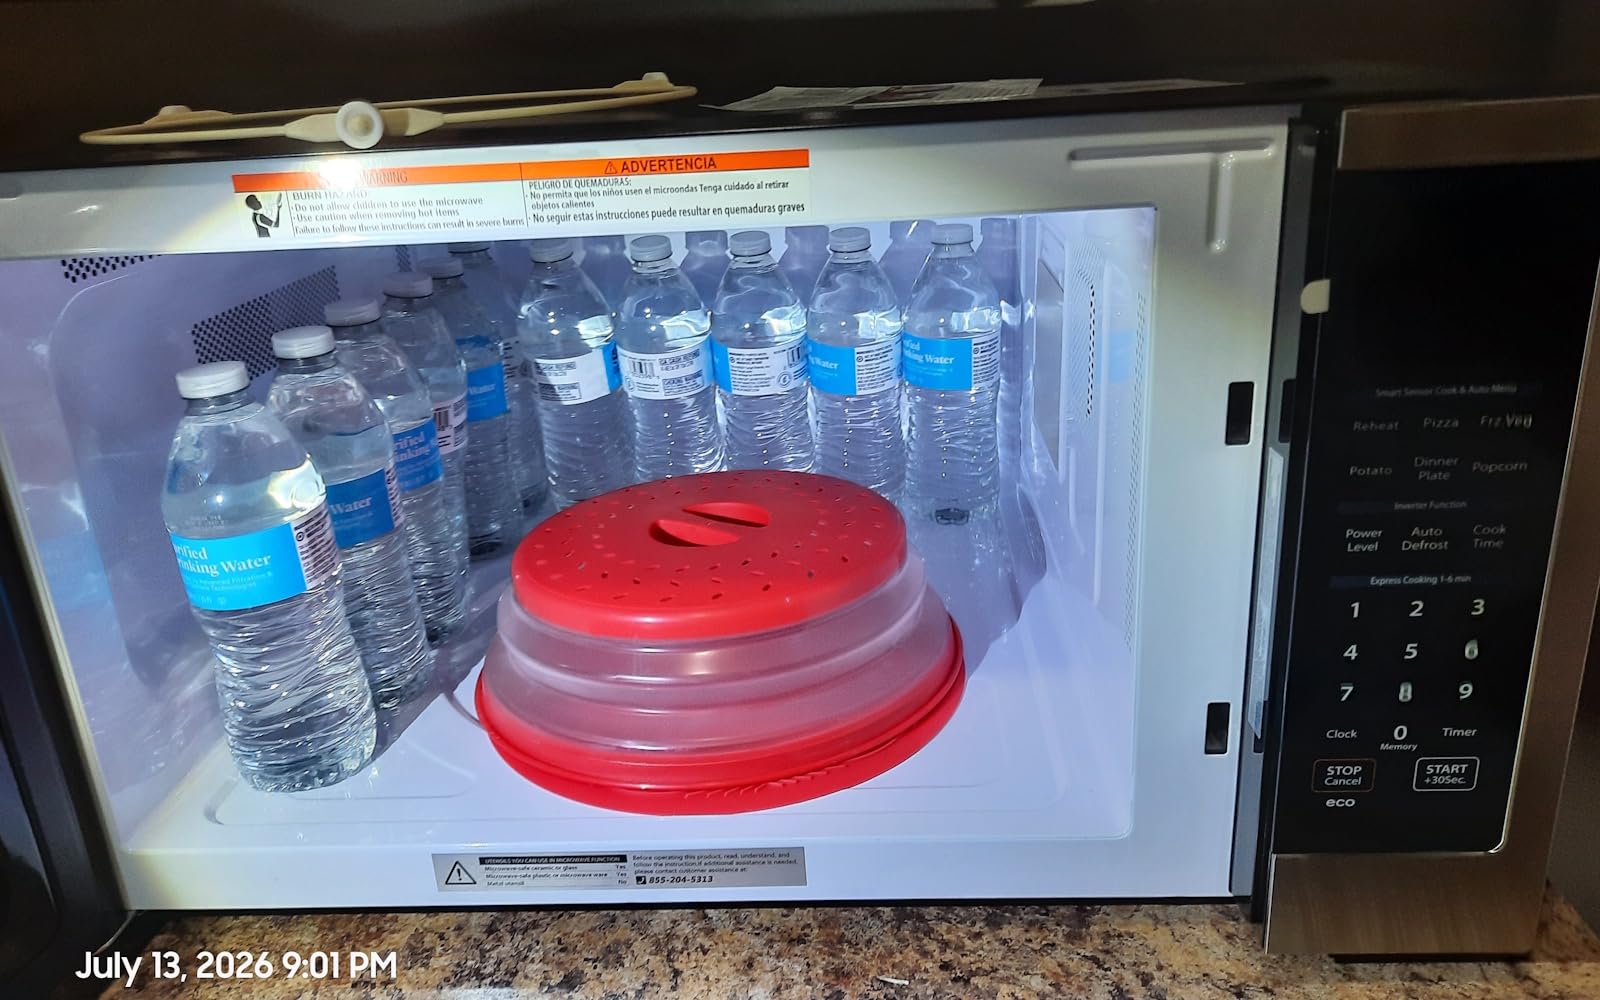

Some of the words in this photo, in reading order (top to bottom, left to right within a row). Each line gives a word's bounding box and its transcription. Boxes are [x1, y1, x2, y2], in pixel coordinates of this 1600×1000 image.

[621, 157, 717, 173] ADVERTENCIA
[361, 171, 408, 185] WARNING
[529, 180, 561, 190] PELIGRO
[562, 180, 573, 188] DE
[574, 178, 632, 187] QUEMADURAS:
[293, 191, 321, 200] BURN
[542, 190, 572, 199] permita
[574, 190, 588, 199] que
[590, 188, 600, 197] los
[602, 187, 624, 196] niños
[626, 187, 643, 195] usen
[645, 186, 652, 194] el
[654, 184, 698, 194] microondas
[700, 184, 722, 193] Tenga
[724, 181, 754, 191] cuidado
[756, 181, 763, 189] al
[765, 181, 789, 189] retirar
[294, 203, 305, 211] Do
[308, 202, 323, 211] not
[327, 202, 350, 210] allow
[353, 200, 387, 209] children
[390, 199, 399, 207] to
[402, 199, 416, 207] use
[419, 198, 433, 206] the
[436, 196, 483, 205] microwave
[531, 201, 560, 210] objetos
[561, 200, 594, 209] calientes
[297, 213, 313, 222] Use
[315, 212, 347, 221] caution
[350, 211, 373, 219] when
[375, 210, 414, 220] removing
[419, 209, 433, 217] hot
[436, 208, 459, 216] items
[533, 213, 544, 222] No
[546, 212, 571, 224] seguir
[573, 211, 594, 220] estas
[595, 209, 649, 220] instrucciones
[651, 208, 677, 219] puede
[679, 206, 710, 216] resultar
[724, 203, 775, 215] quemaduras
[778, 203, 805, 213] graves
[295, 225, 320, 234] Failure
[322, 225, 330, 233] to
[332, 223, 357, 232] follow
[359, 222, 379, 231] these
[381, 220, 425, 231] instructions
[443, 219, 465, 228] result
[467, 220, 474, 228] in
[476, 219, 500, 227] severe
[503, 217, 523, 226] burns
[925, 354, 954, 365] Water
[1376, 389, 1402, 397] Smart
[1404, 388, 1433, 396] Sensor
[1491, 384, 1517, 392] Menu
[1353, 421, 1399, 431] Reheat
[1424, 418, 1459, 428] Pizza
[1481, 416, 1500, 426] Frz
[1506, 415, 1532, 429] Veg
[1414, 457, 1458, 467] Dinner
[1473, 462, 1527, 473] Popcorn
[1350, 466, 1392, 476] Potato
[1418, 471, 1450, 481] Plate
[330, 497, 372, 515] Water
[1394, 502, 1427, 510] Inverter
[1430, 501, 1467, 509] Function
[1346, 529, 1382, 538] Power
[1412, 527, 1442, 536] Auto
[1473, 525, 1506, 535] Cook
[1348, 542, 1378, 552] Level
[1402, 540, 1448, 551] Defrost
[1473, 538, 1504, 548] Time
[220, 555, 271, 573] Water
[1370, 577, 1401, 586] Express
[1403, 576, 1437, 585] Cooking
[1440, 575, 1453, 583] 1-6
[1351, 603, 1360, 617] 1
[1409, 601, 1424, 616] 2
[1471, 599, 1485, 615] 3
[1343, 644, 1358, 660] 4
[1404, 643, 1418, 659] 5
[1465, 639, 1478, 660] 6
[1340, 683, 1354, 701] 7
[1399, 682, 1412, 702] 8
[1459, 683, 1473, 699] 9
[1326, 730, 1357, 738] Clock
[1394, 725, 1407, 740] 0
[1442, 727, 1477, 736] Timer
[1327, 766, 1362, 775] STOP
[1426, 764, 1468, 774] START
[1325, 777, 1361, 785] Cancel
[1326, 798, 1355, 807] eco
[649, 876, 713, 884] 855-204-5313
